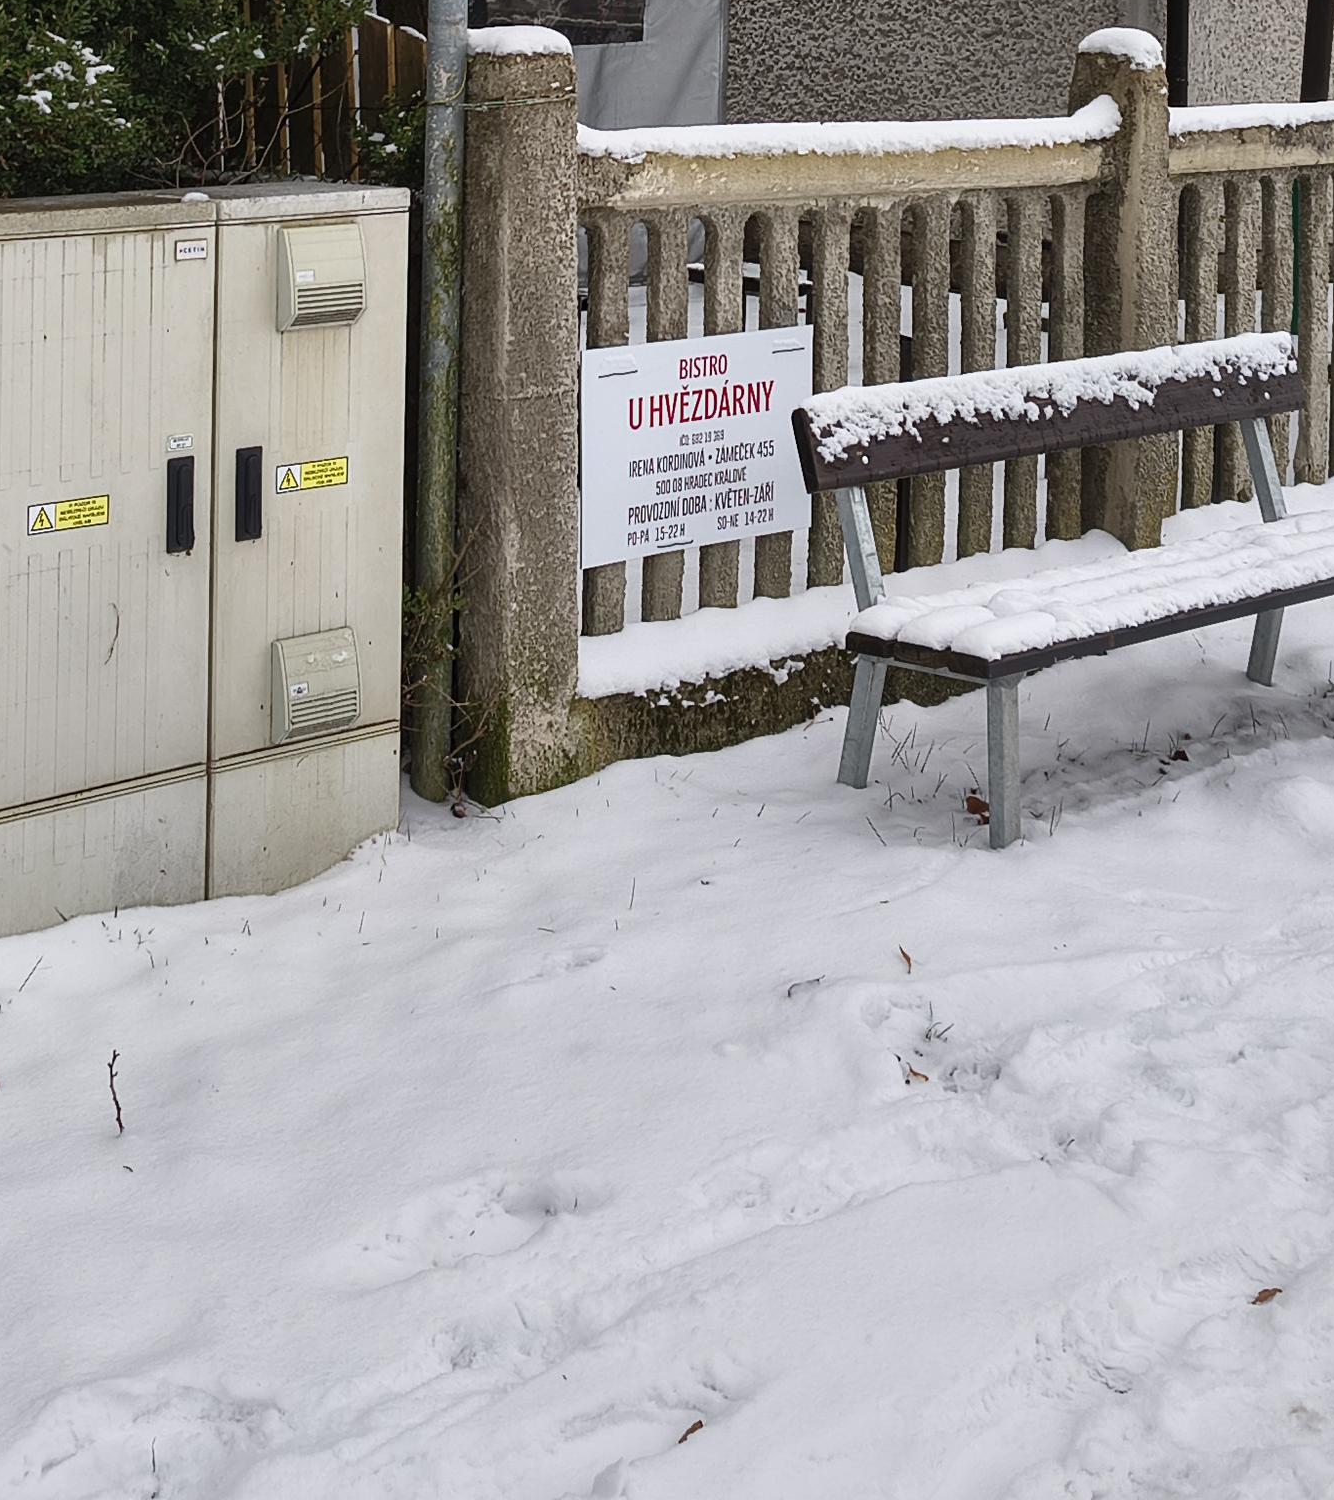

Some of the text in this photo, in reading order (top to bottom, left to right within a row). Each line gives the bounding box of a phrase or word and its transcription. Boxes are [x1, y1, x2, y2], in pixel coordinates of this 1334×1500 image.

[679, 354, 727, 380] BISTRO
[629, 380, 774, 430] U HVĚZDÁRNY
[629, 440, 775, 478] IRENA KORDINOVÁ ZÁMEČEK 455
[656, 479, 670, 496] 500
[672, 478, 683, 492] 08
[684, 472, 713, 491] HRADEC
[682, 495, 707, 516] DOBA
[715, 480, 774, 511] KVĚTEN-ZÁŘÍ
[655, 524, 678, 542] 15-22
[680, 524, 685, 536] H
[717, 514, 739, 530] SO-NE
[744, 510, 767, 526] 14-22
[769, 508, 774, 521] H
